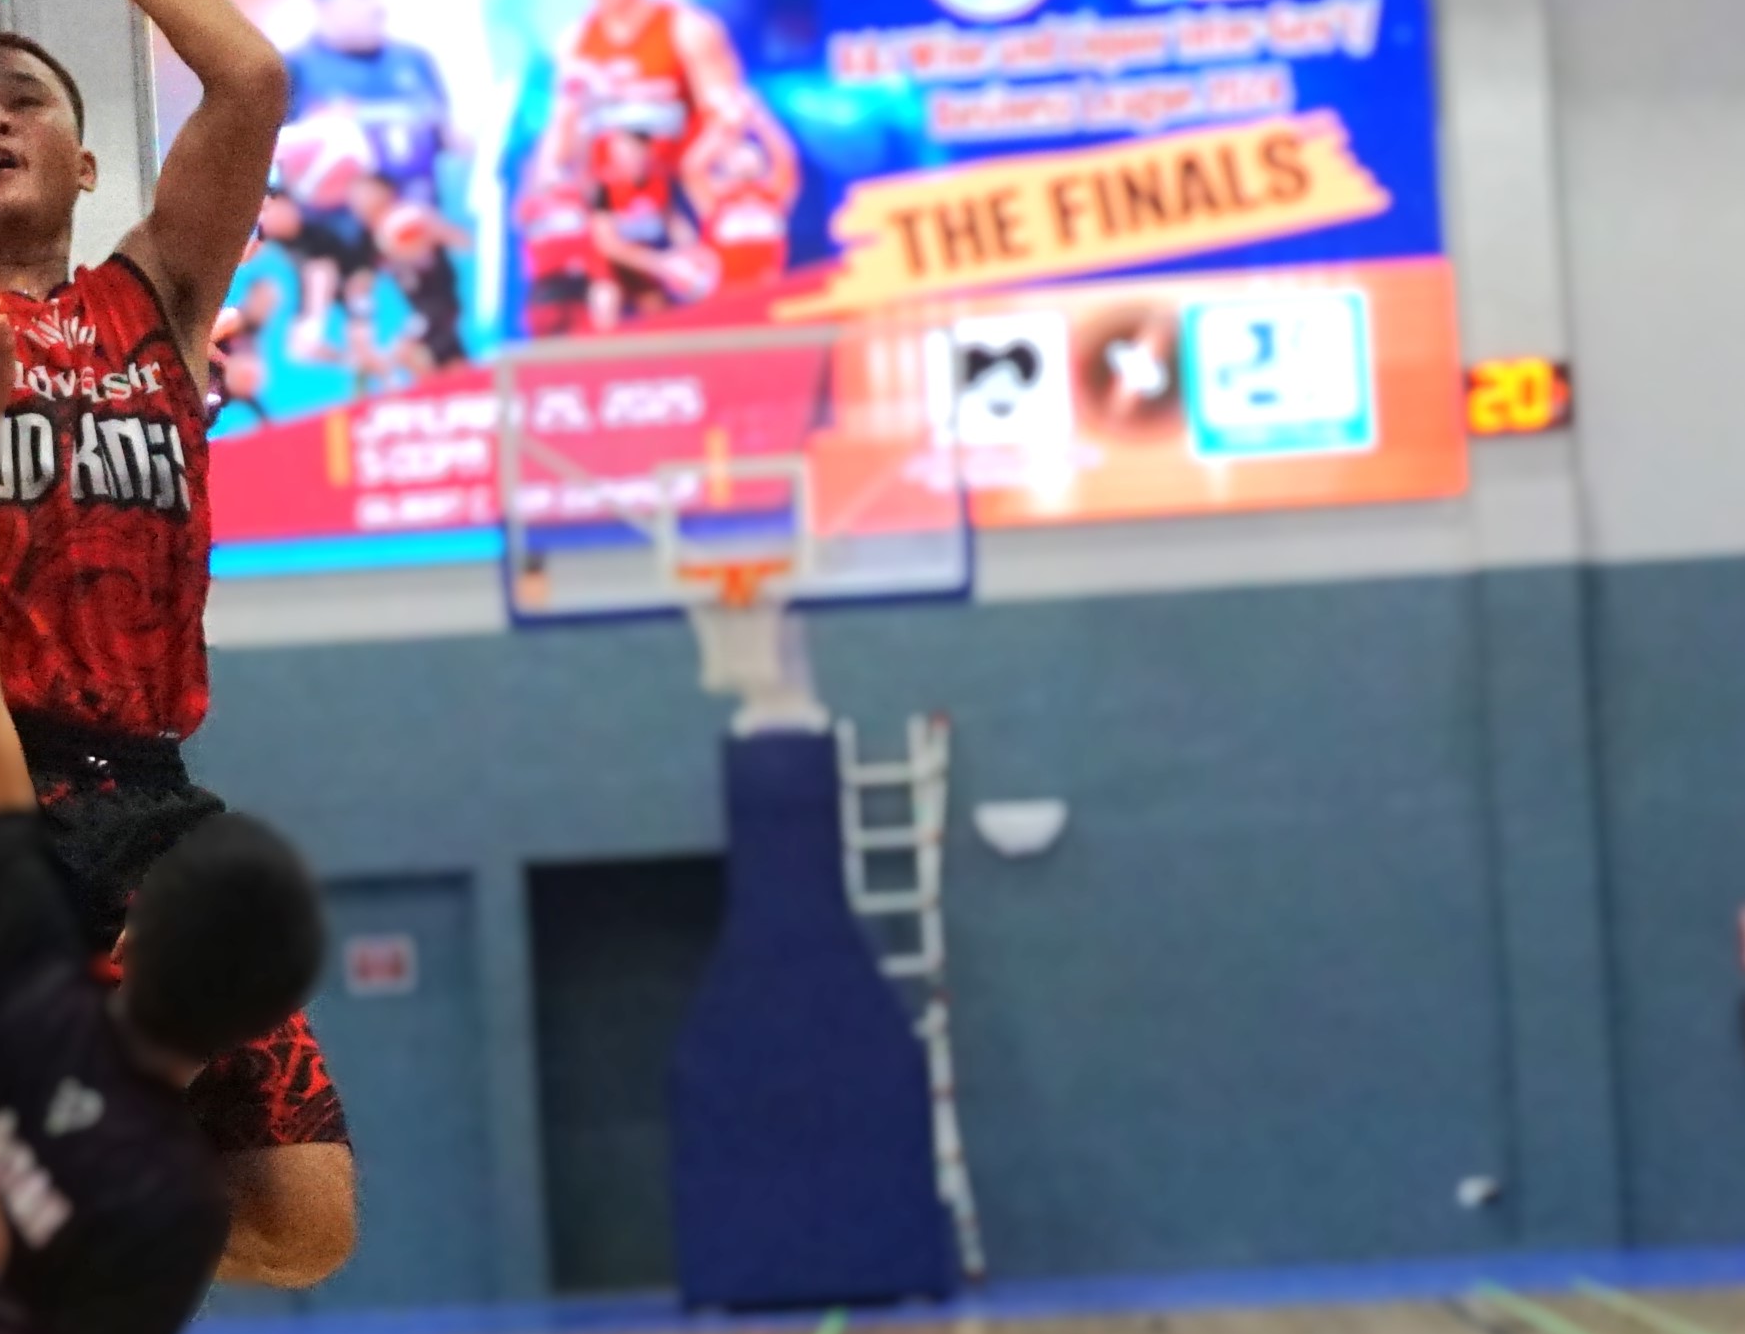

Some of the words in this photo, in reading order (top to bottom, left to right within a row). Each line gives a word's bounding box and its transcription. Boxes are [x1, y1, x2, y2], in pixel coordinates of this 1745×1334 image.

[888, 187, 1030, 279] THE
[1046, 131, 1312, 249] FINALS
[1468, 357, 1554, 435] 20
